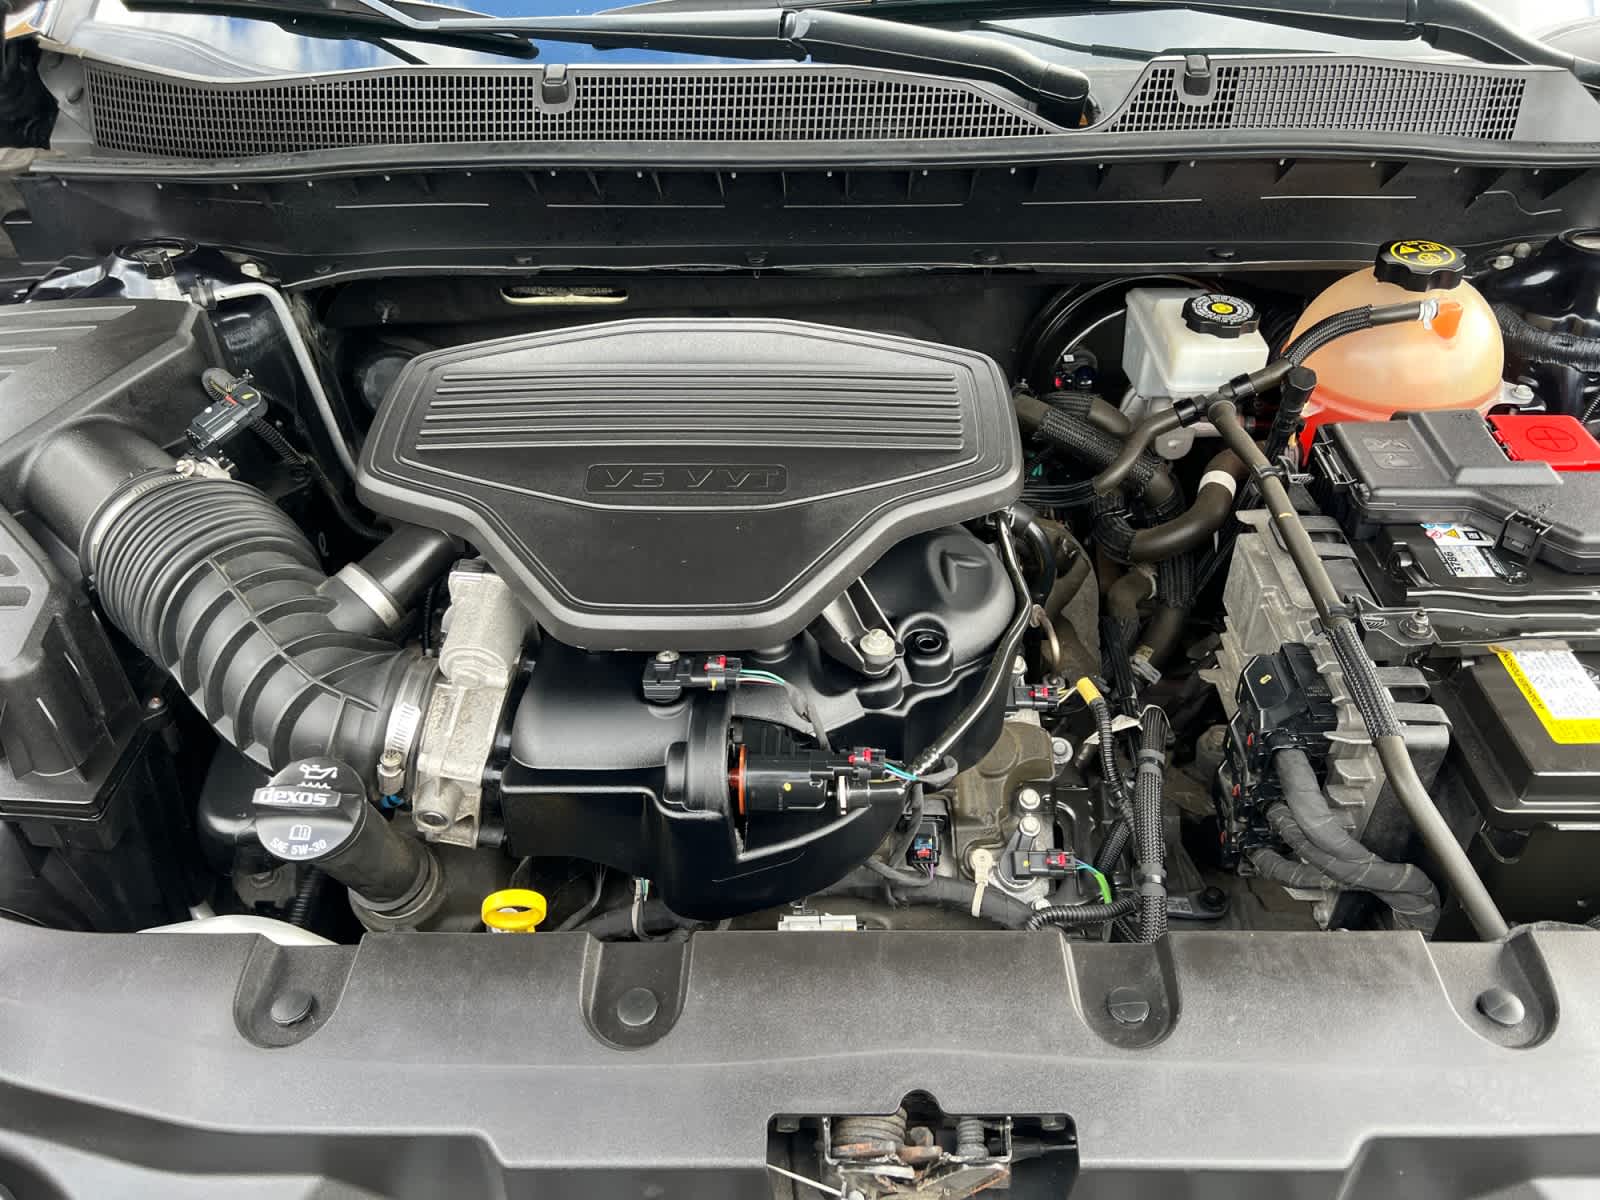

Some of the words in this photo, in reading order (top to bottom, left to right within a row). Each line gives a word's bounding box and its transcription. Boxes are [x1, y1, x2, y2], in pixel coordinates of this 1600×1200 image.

[683, 468, 780, 488] VVT
[258, 787, 331, 806] dexos
[270, 837, 289, 854] SAE
[290, 839, 327, 855] 5W-30
